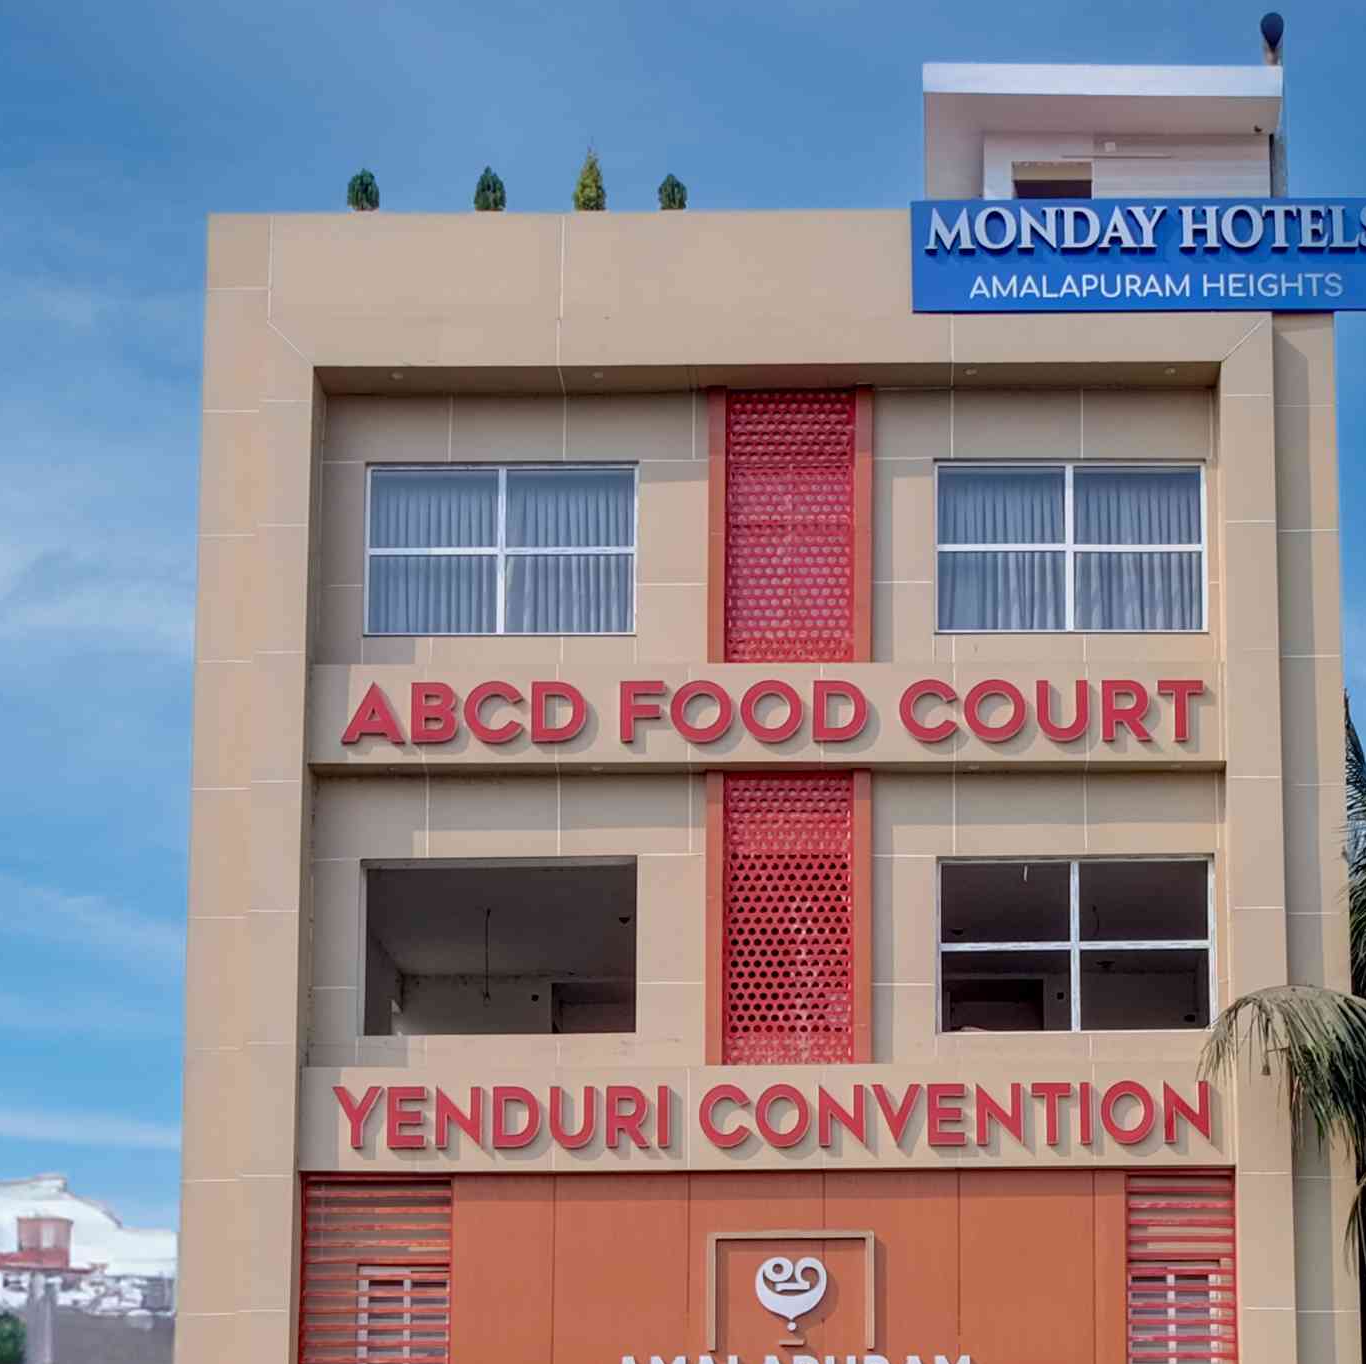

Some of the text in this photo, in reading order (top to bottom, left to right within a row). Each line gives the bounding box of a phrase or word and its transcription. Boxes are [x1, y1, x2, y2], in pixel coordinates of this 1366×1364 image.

[925, 206, 1167, 255] MONDAY
[969, 272, 1345, 300] AMALAPURAM HEIGHTS
[341, 678, 1203, 745] ABCD FOOD COURT
[332, 1080, 1214, 1150] YENDURI CONVENTION
